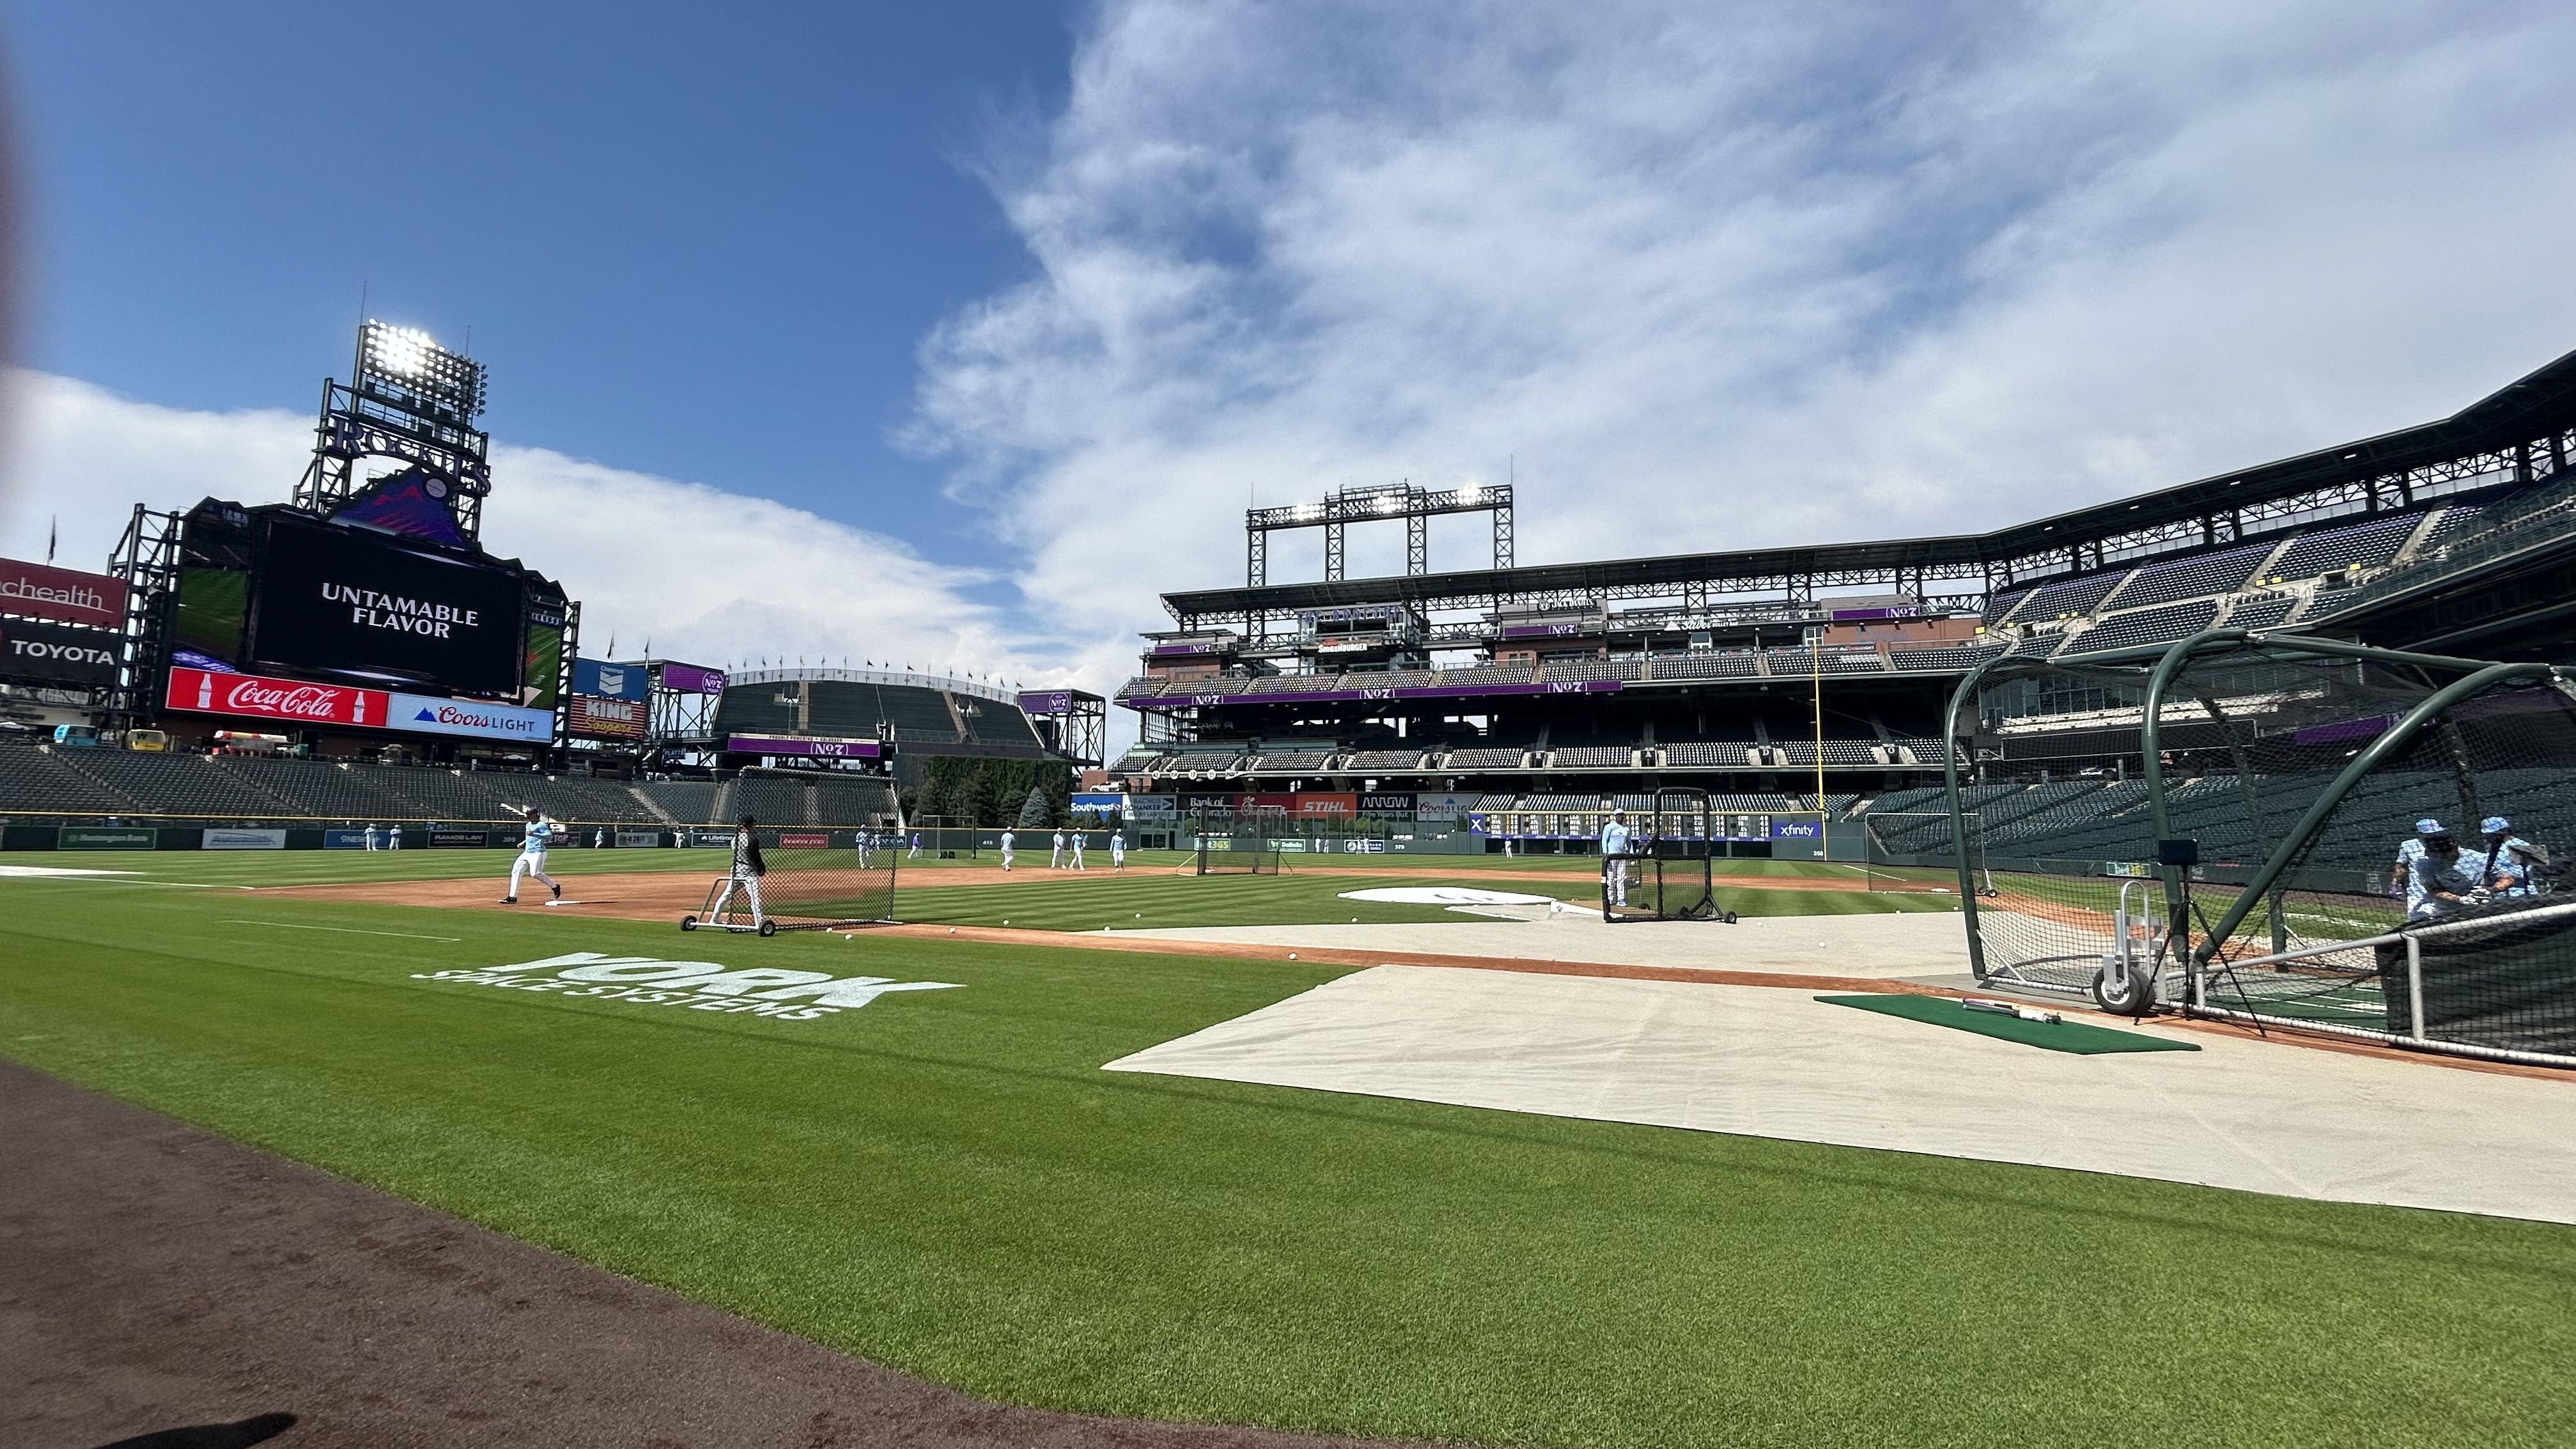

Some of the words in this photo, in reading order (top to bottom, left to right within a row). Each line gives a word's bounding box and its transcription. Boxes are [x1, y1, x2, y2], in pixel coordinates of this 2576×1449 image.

[333, 417, 491, 497] ROCKIES
[0, 577, 102, 609] chealth
[322, 583, 478, 626] UNTAMABLE
[1333, 606, 1400, 621] ROOFTOP
[353, 607, 449, 638] FLAVOR
[11, 640, 114, 665] TOYOTA
[600, 665, 624, 674] Chevron
[228, 681, 341, 716] Coca-Cola
[439, 706, 489, 727] Coors
[492, 718, 534, 732] LIGHT
[586, 701, 632, 720] KING
[584, 716, 632, 734] Soopers
[1071, 802, 1113, 812] Southwest
[1190, 797, 1213, 806] Bank
[1214, 796, 1224, 805] of
[1304, 802, 1347, 812] STIHL
[1363, 797, 1408, 807] ARROW
[1419, 802, 1450, 814] Coors
[1781, 824, 1813, 836] xfinity
[479, 952, 966, 1008] YORK
[410, 970, 589, 991] SPACE
[563, 986, 841, 1019] SYSTEMS
